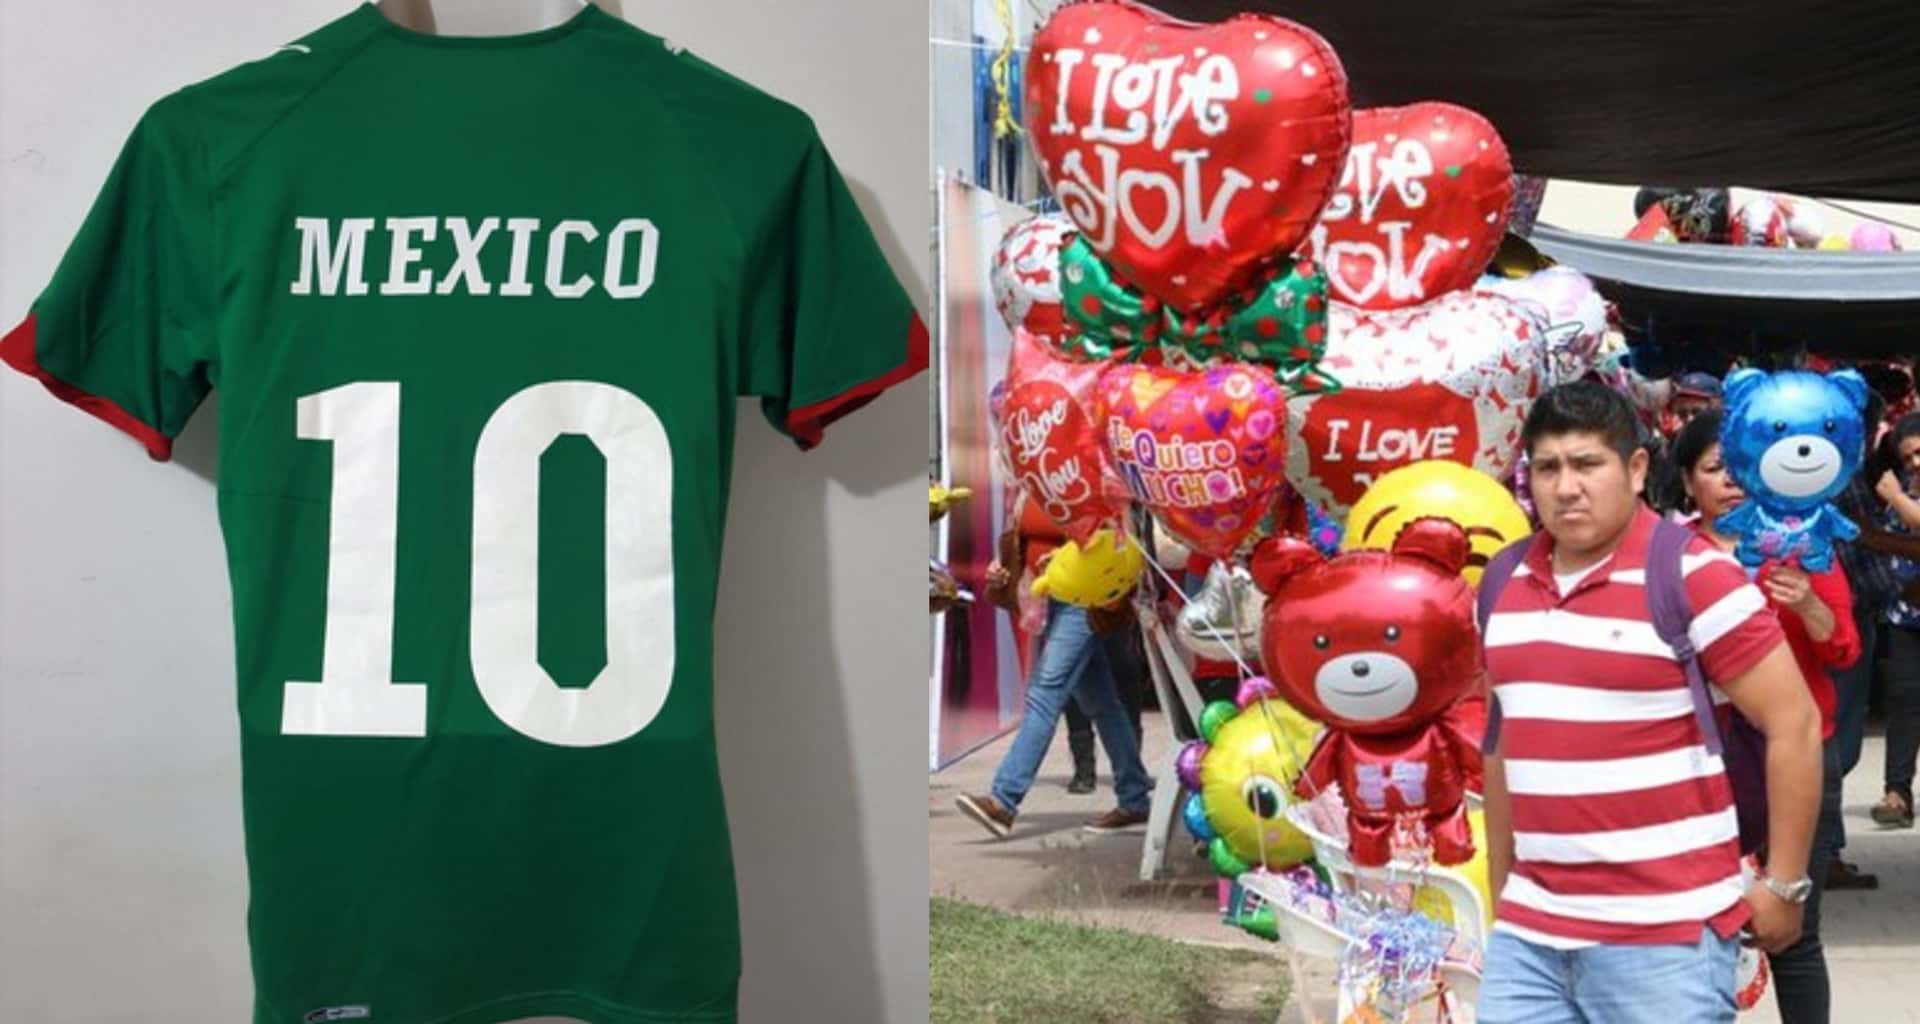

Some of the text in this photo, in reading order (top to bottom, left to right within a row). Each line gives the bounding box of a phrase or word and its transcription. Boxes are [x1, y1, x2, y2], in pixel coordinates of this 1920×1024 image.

[1050, 48, 1084, 135] I
[291, 216, 660, 299] MEXICO
[1132, 427, 1237, 472] Quiero
[1322, 419, 1459, 461] I LOVE
[281, 380, 676, 747] 10
